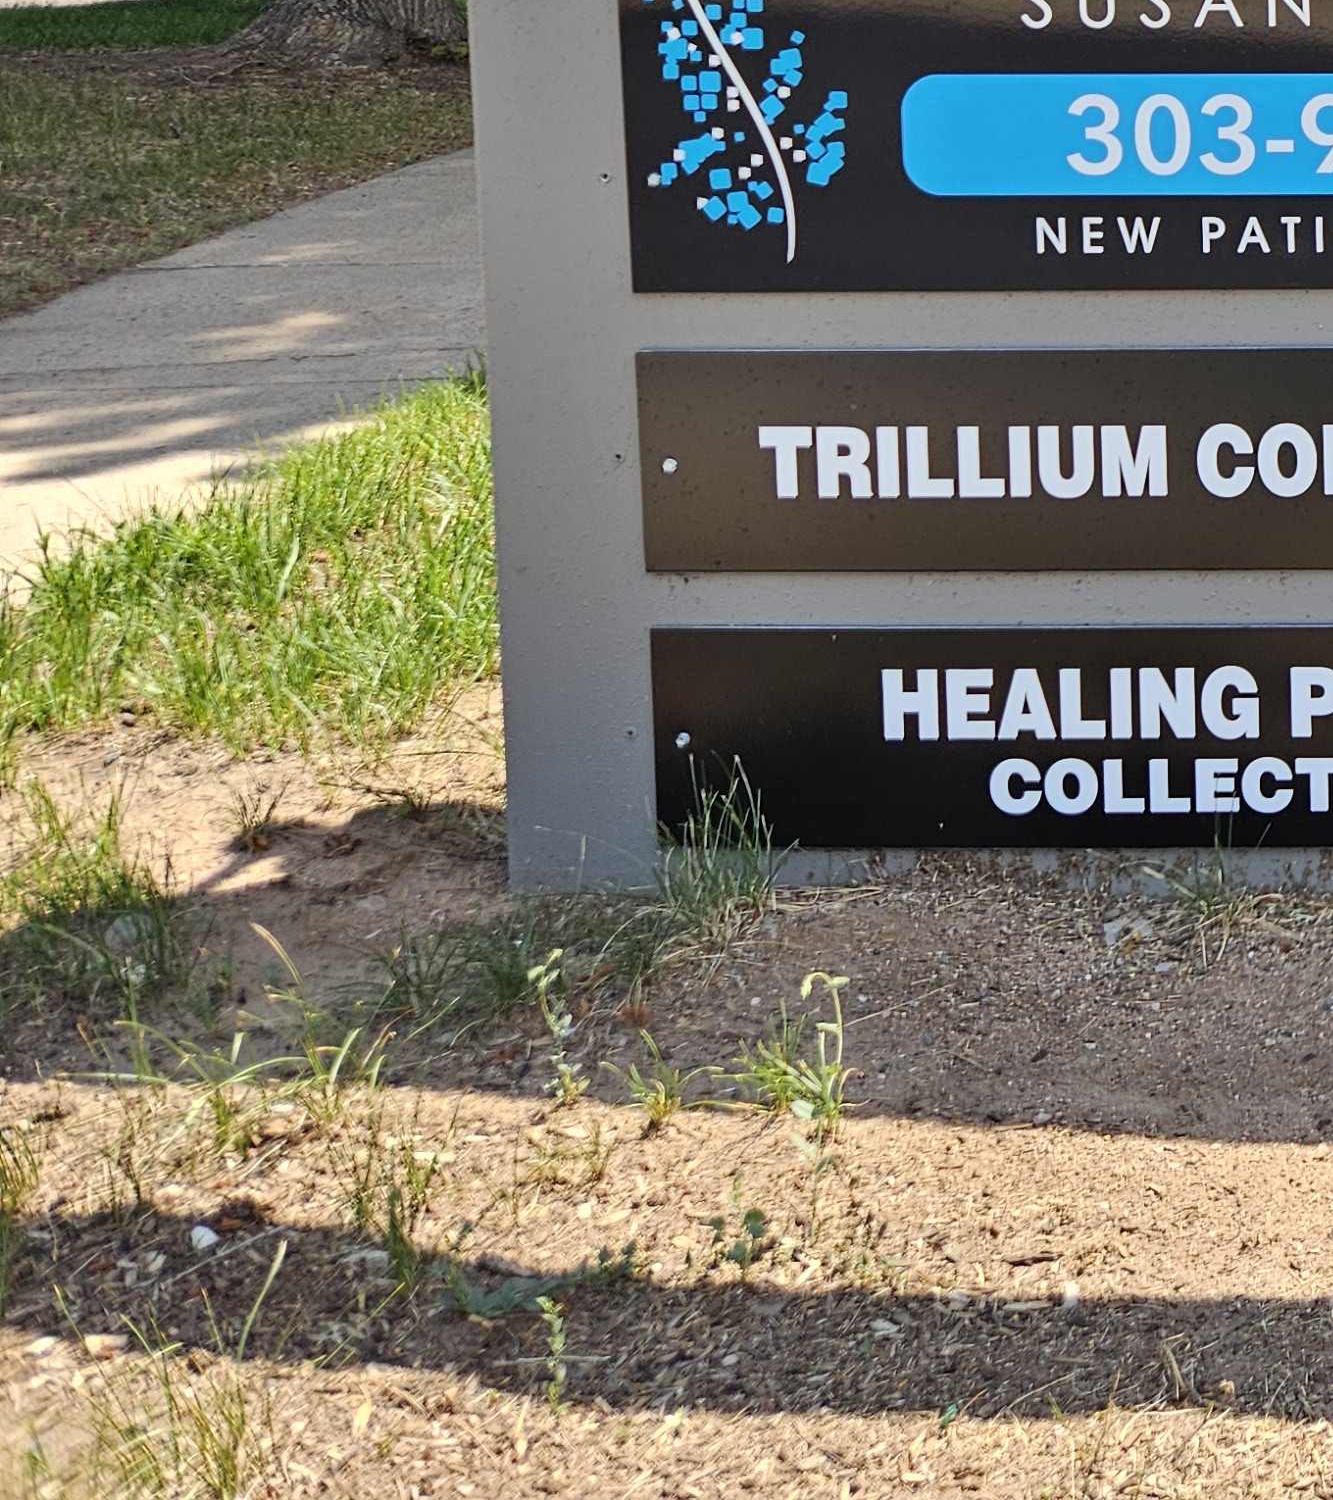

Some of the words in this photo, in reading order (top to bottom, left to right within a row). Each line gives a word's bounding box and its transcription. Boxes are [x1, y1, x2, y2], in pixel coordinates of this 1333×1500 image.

[1036, 217, 1160, 254] NEW
[759, 426, 1168, 498] TRILLIUM
[882, 666, 1259, 740] HEALING
